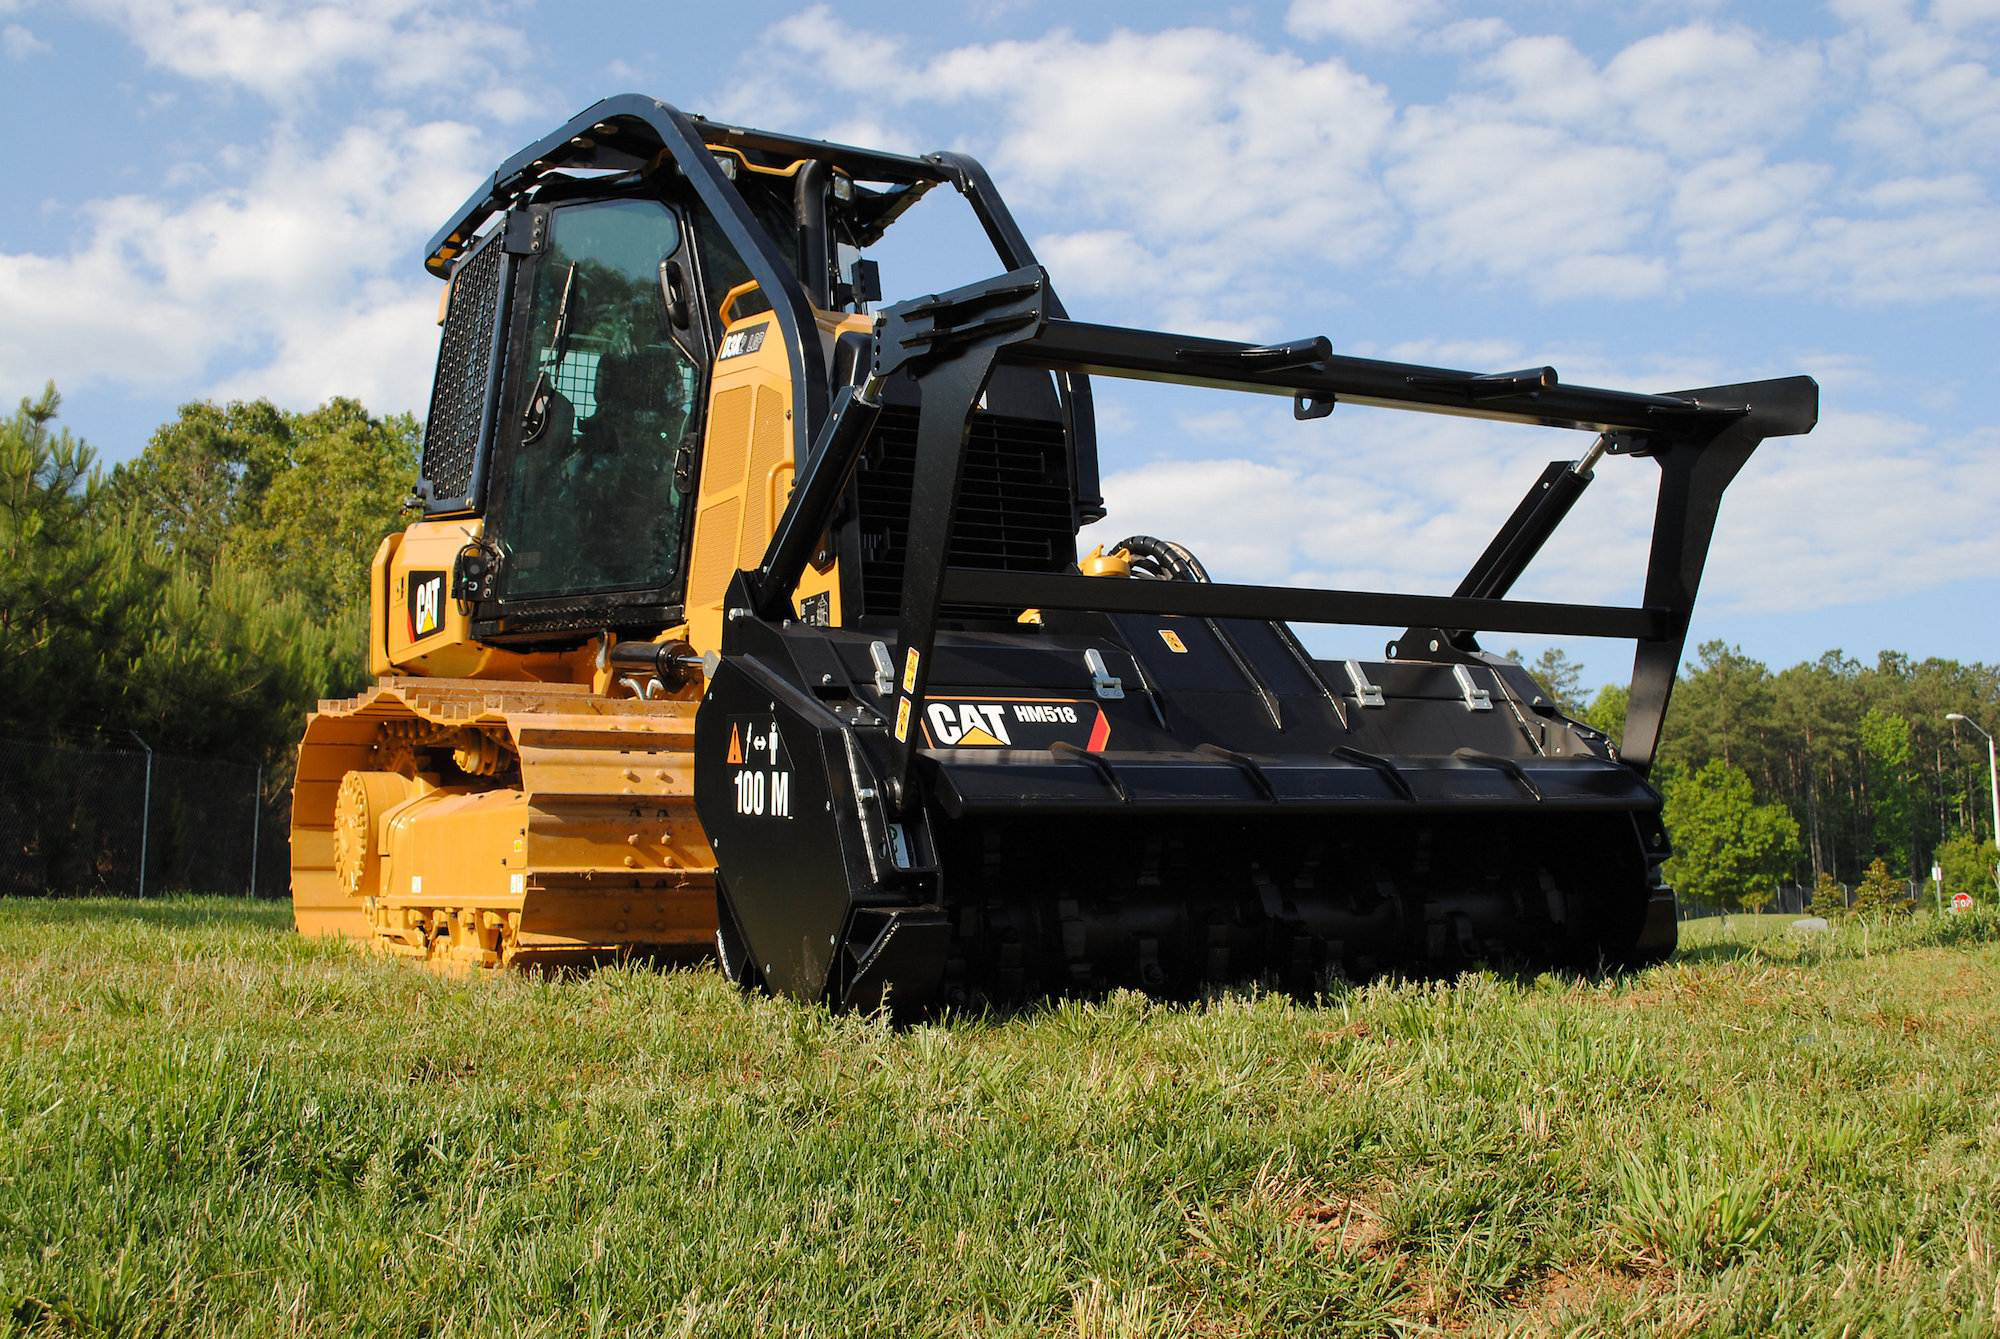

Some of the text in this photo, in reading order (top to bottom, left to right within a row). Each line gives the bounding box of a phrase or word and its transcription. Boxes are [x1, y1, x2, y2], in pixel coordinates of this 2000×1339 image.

[416, 577, 440, 634] CAT
[927, 703, 1078, 746] CAT HM518
[734, 770, 789, 816] 100 M
